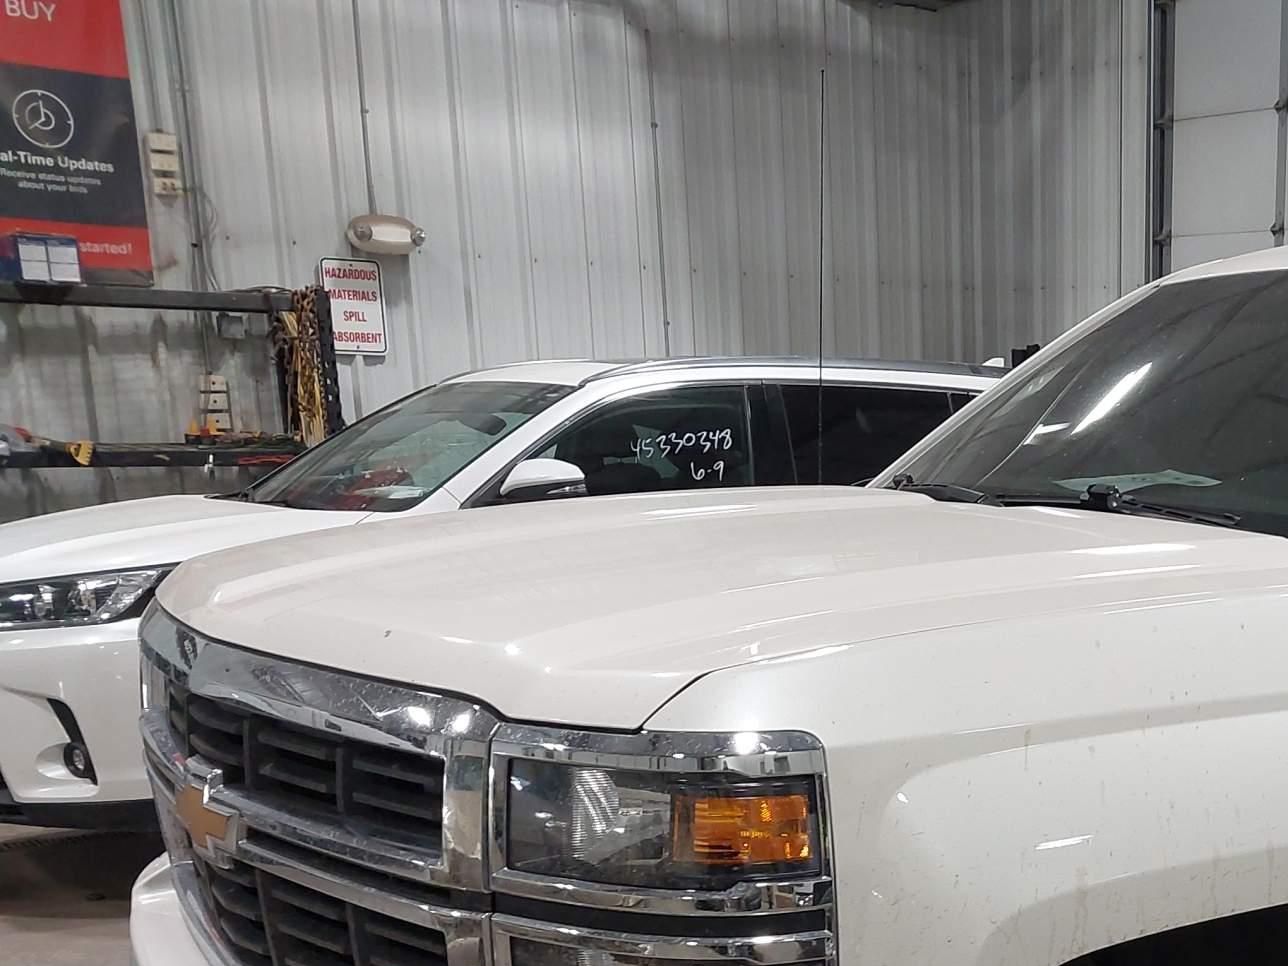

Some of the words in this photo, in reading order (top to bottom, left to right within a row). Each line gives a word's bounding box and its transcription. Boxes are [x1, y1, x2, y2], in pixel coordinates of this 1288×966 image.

[5, 0, 56, 22] BUY
[57, 156, 115, 173] Updates
[47, 184, 67, 192] your
[324, 267, 377, 281] HAZARDOUS
[328, 288, 378, 302] MATERIALS
[343, 310, 368, 322] SPILL
[332, 331, 383, 344] ABSORBENT
[631, 428, 733, 461] 45330348
[690, 461, 725, 482] 6-9
